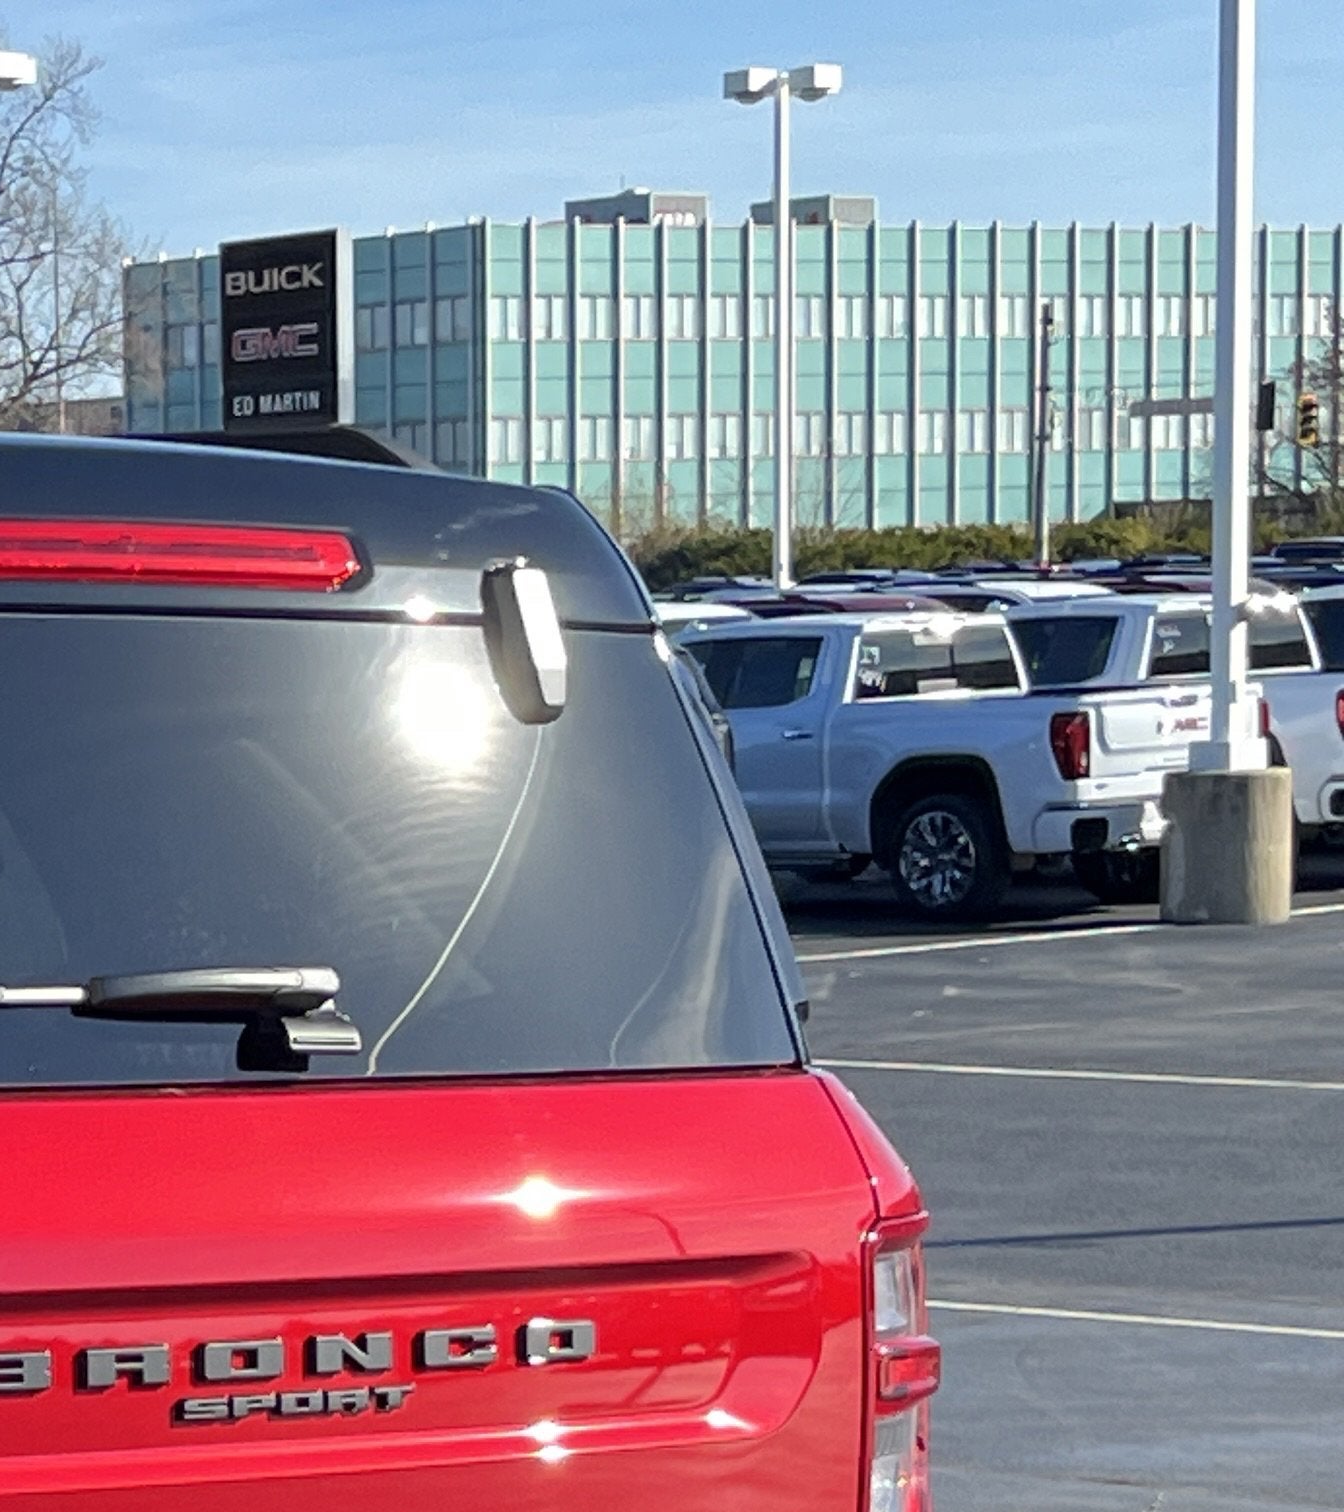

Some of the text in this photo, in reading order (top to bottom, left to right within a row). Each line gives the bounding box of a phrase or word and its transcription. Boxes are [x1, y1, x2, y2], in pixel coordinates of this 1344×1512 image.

[224, 262, 324, 297] BUICK
[231, 322, 319, 362] GMC
[232, 391, 321, 417] ED MARTIN
[173, 1384, 414, 1425] SPORT
